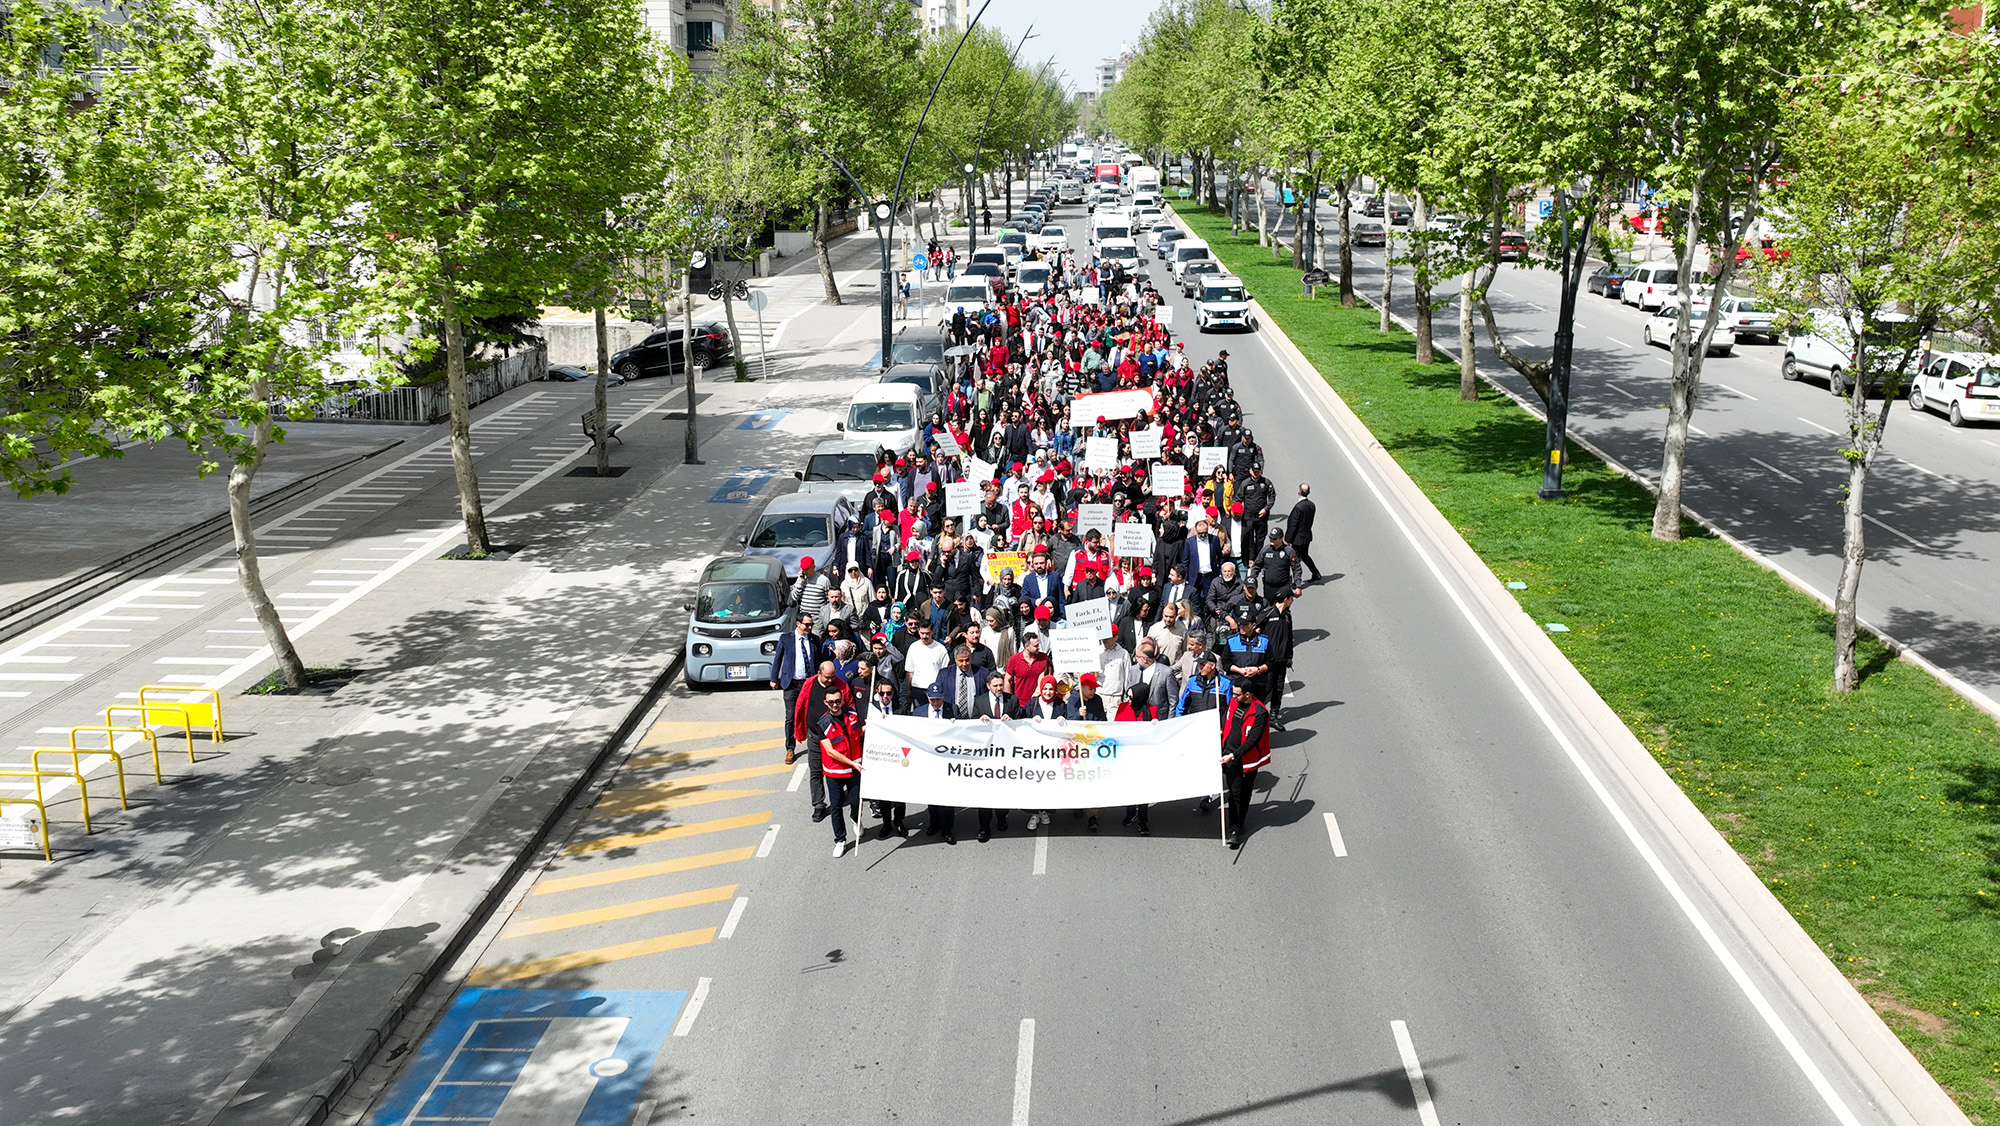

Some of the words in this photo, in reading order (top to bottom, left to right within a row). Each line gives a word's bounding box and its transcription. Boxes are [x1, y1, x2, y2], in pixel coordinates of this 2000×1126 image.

[1076, 609, 1091, 617] Fark
[1073, 616, 1107, 627] Yanımızda
[934, 744, 1005, 759] Otizmin
[1012, 744, 1090, 759] Farkında
[1097, 744, 1117, 759] Ol
[948, 763, 1056, 783] Mücadeleye
[1064, 766, 1112, 782] Başla
